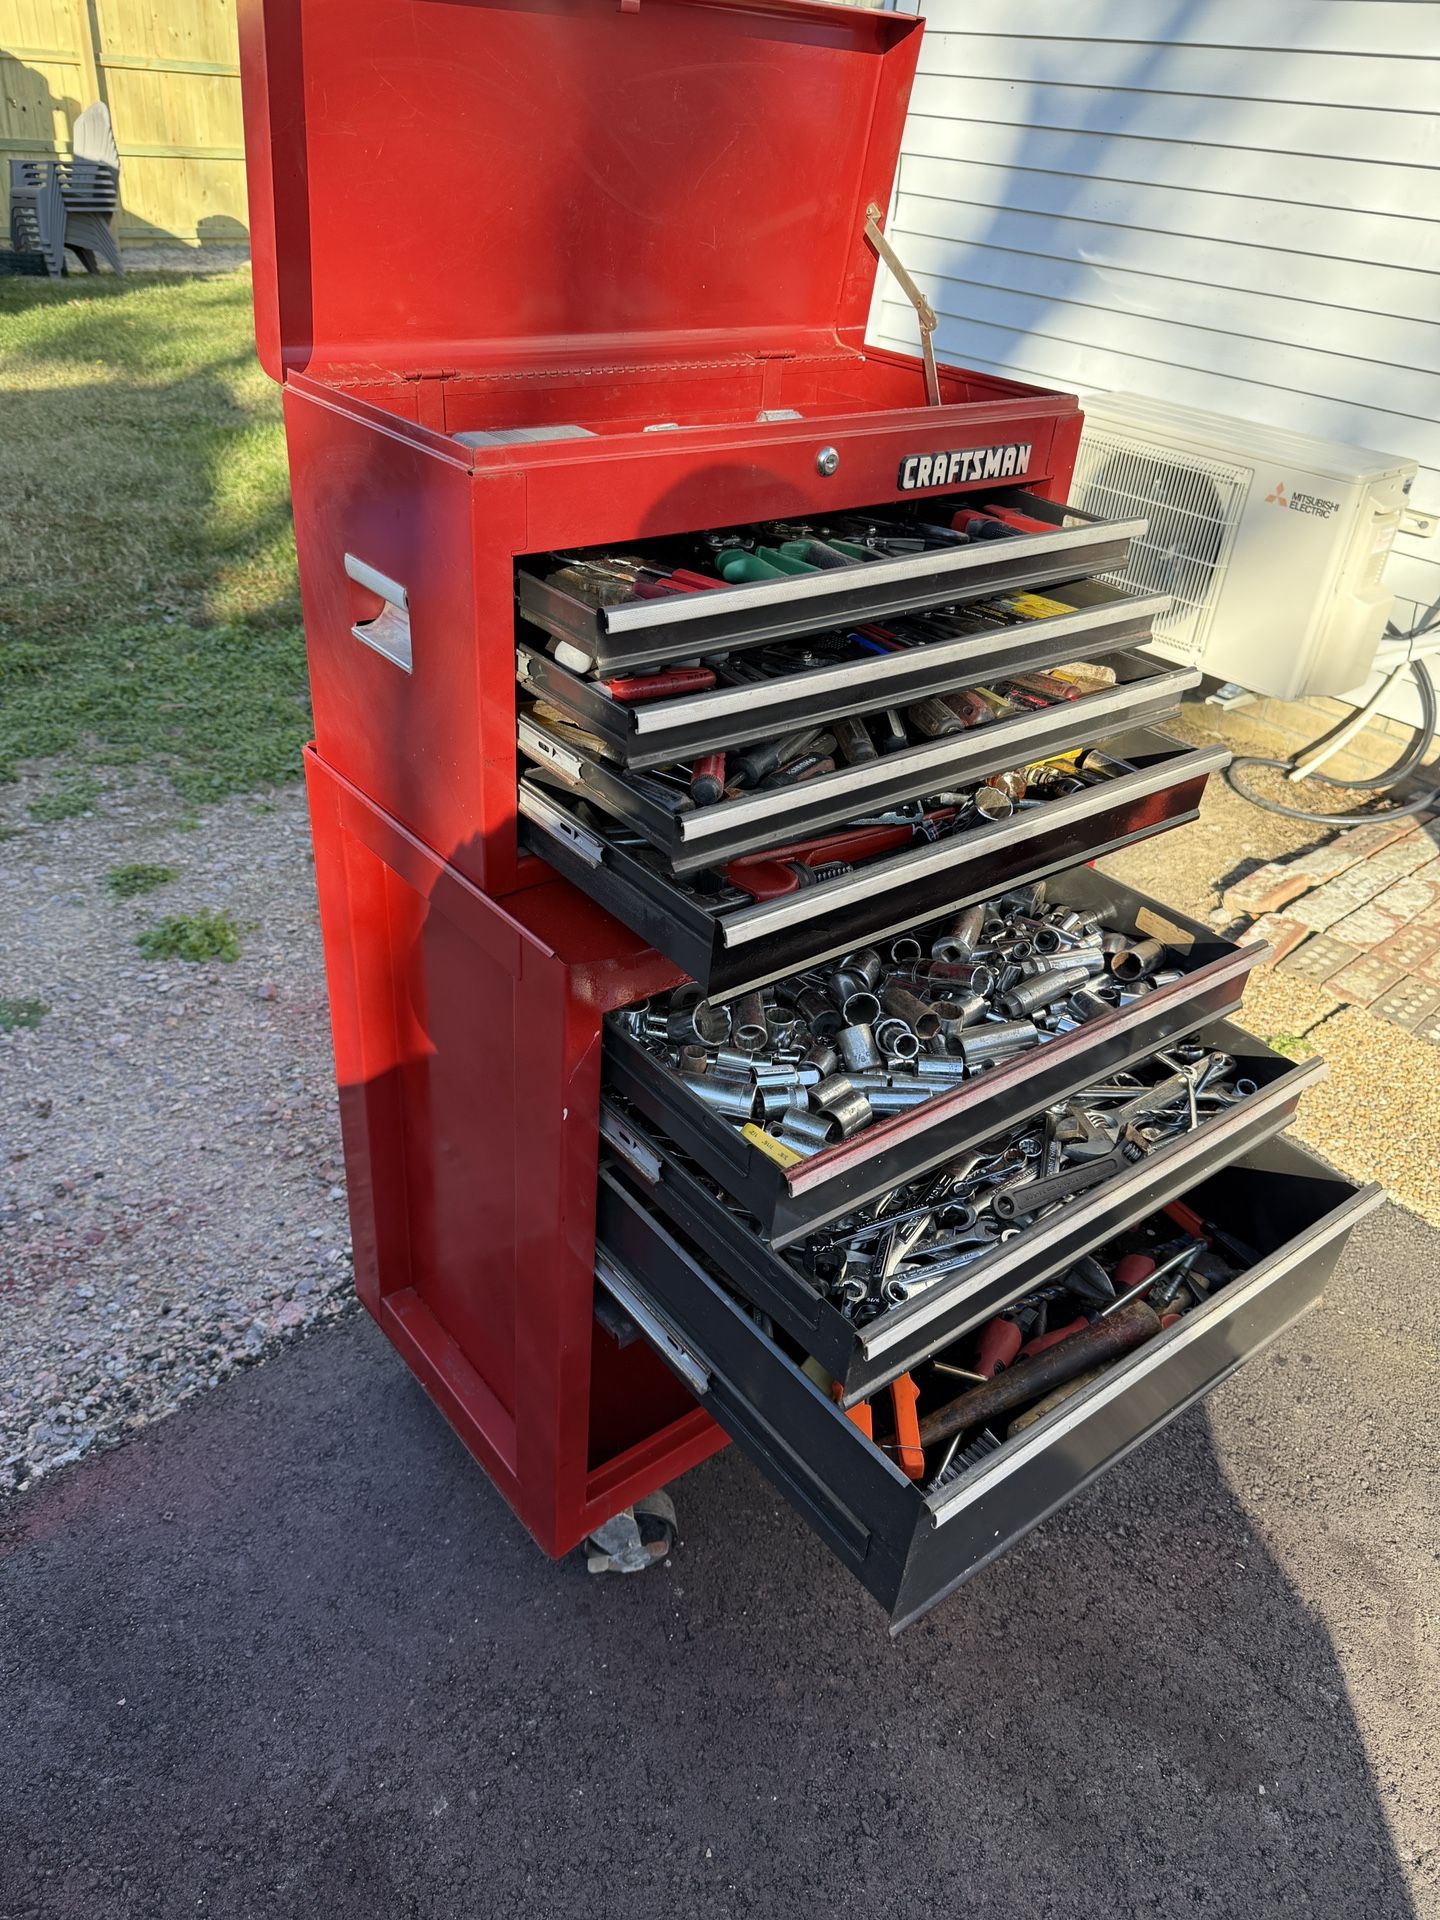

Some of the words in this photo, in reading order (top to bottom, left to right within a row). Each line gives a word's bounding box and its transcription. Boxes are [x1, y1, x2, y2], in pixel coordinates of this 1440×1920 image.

[902, 445, 1032, 489] CRAFTSMAN
[1289, 501, 1331, 519] ELECTRIC
[1291, 492, 1340, 512] MITSUBISHI
